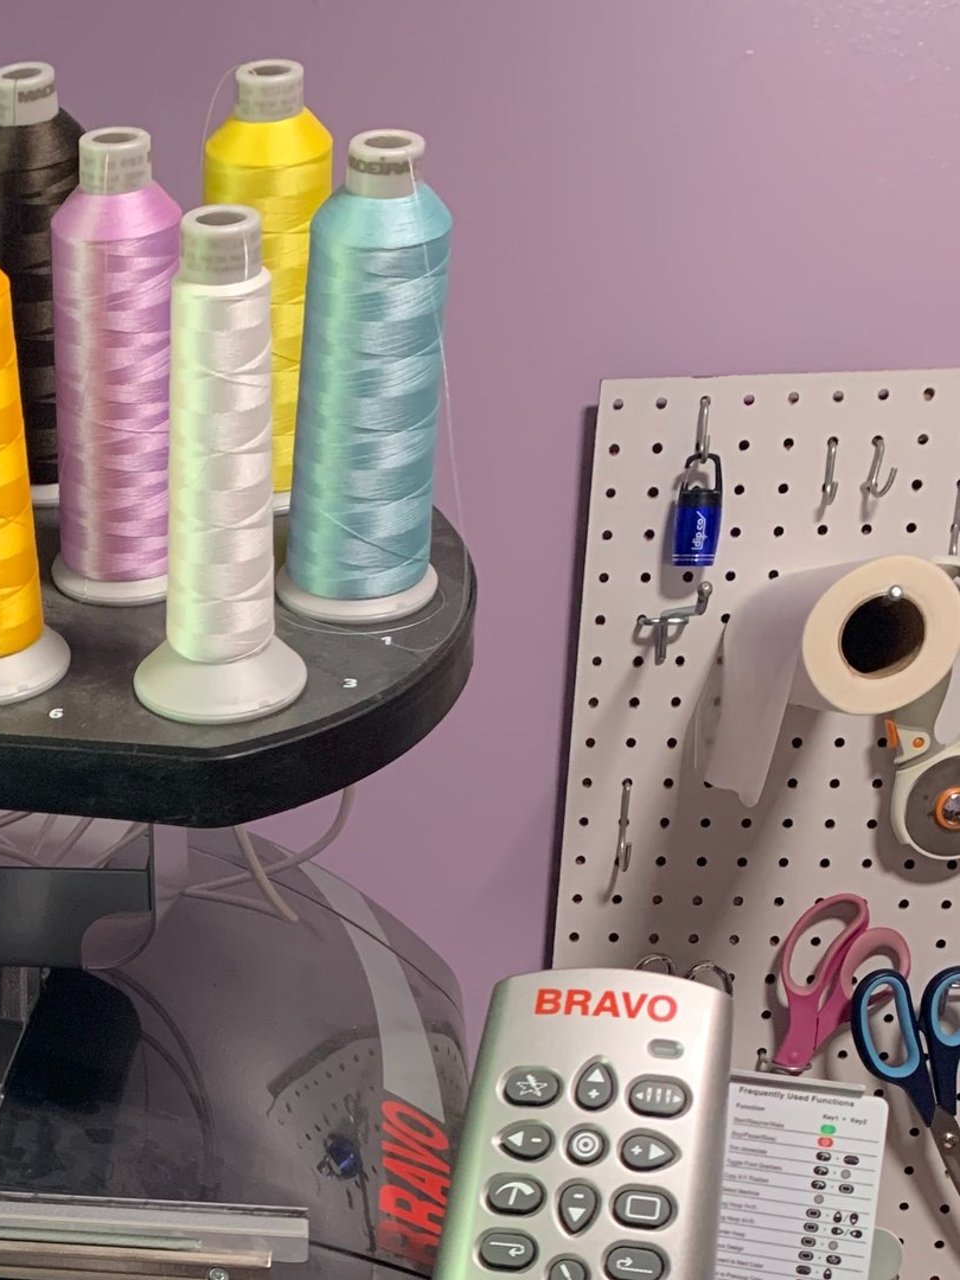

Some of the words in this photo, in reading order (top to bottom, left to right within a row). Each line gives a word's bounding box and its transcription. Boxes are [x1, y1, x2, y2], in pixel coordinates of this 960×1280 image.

[381, 636, 392, 646] 1
[342, 678, 358, 688] 3
[49, 708, 64, 718] 6
[534, 988, 678, 1022] BRAVO
[739, 1087, 784, 1100] Frequently
[787, 1093, 809, 1102] Used
[811, 1095, 855, 1107] Functions
